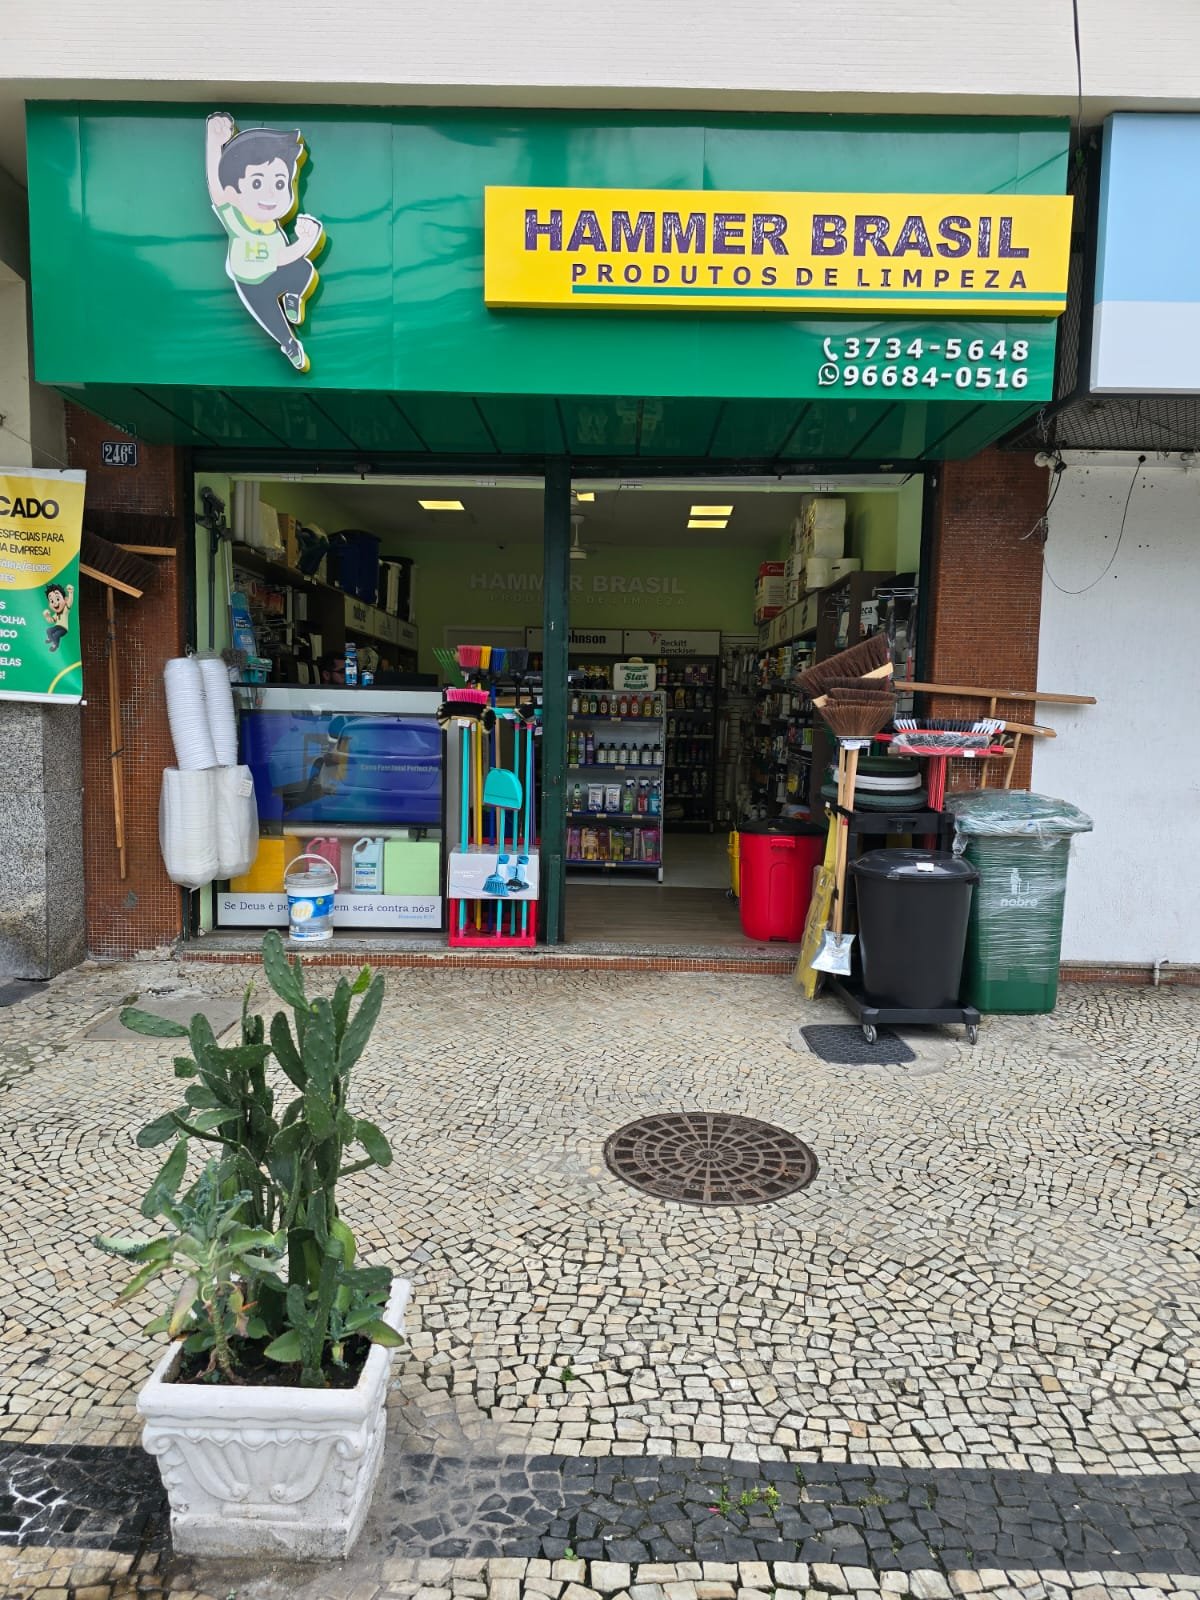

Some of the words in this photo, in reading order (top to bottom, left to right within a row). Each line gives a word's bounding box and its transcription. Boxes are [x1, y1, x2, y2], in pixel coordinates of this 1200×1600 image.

[525, 209, 789, 255] HAMMER
[811, 214, 1029, 258] BRASIL
[572, 263, 777, 286] PRODUTOS
[796, 267, 838, 286] DE
[857, 268, 1026, 288] LIMPEZA
[843, 337, 1028, 361] 3734-5648
[843, 365, 1028, 388] 96684-0516
[42, 532, 65, 542] PARA
[10, 544, 51, 556] EMPRESA!
[471, 573, 583, 592] HAMMR
[593, 575, 687, 594] BRASIL
[661, 640, 687, 649] Reckitt
[0, 657, 21, 667] ELAS
[1000, 895, 1037, 906] nobre
[224, 901, 236, 910] Se
[240, 901, 266, 910] Deus
[268, 902, 274, 910] é
[277, 904, 289, 913] po
[352, 903, 374, 912] será
[377, 904, 409, 912] contra
[412, 904, 435, 913] nós?
